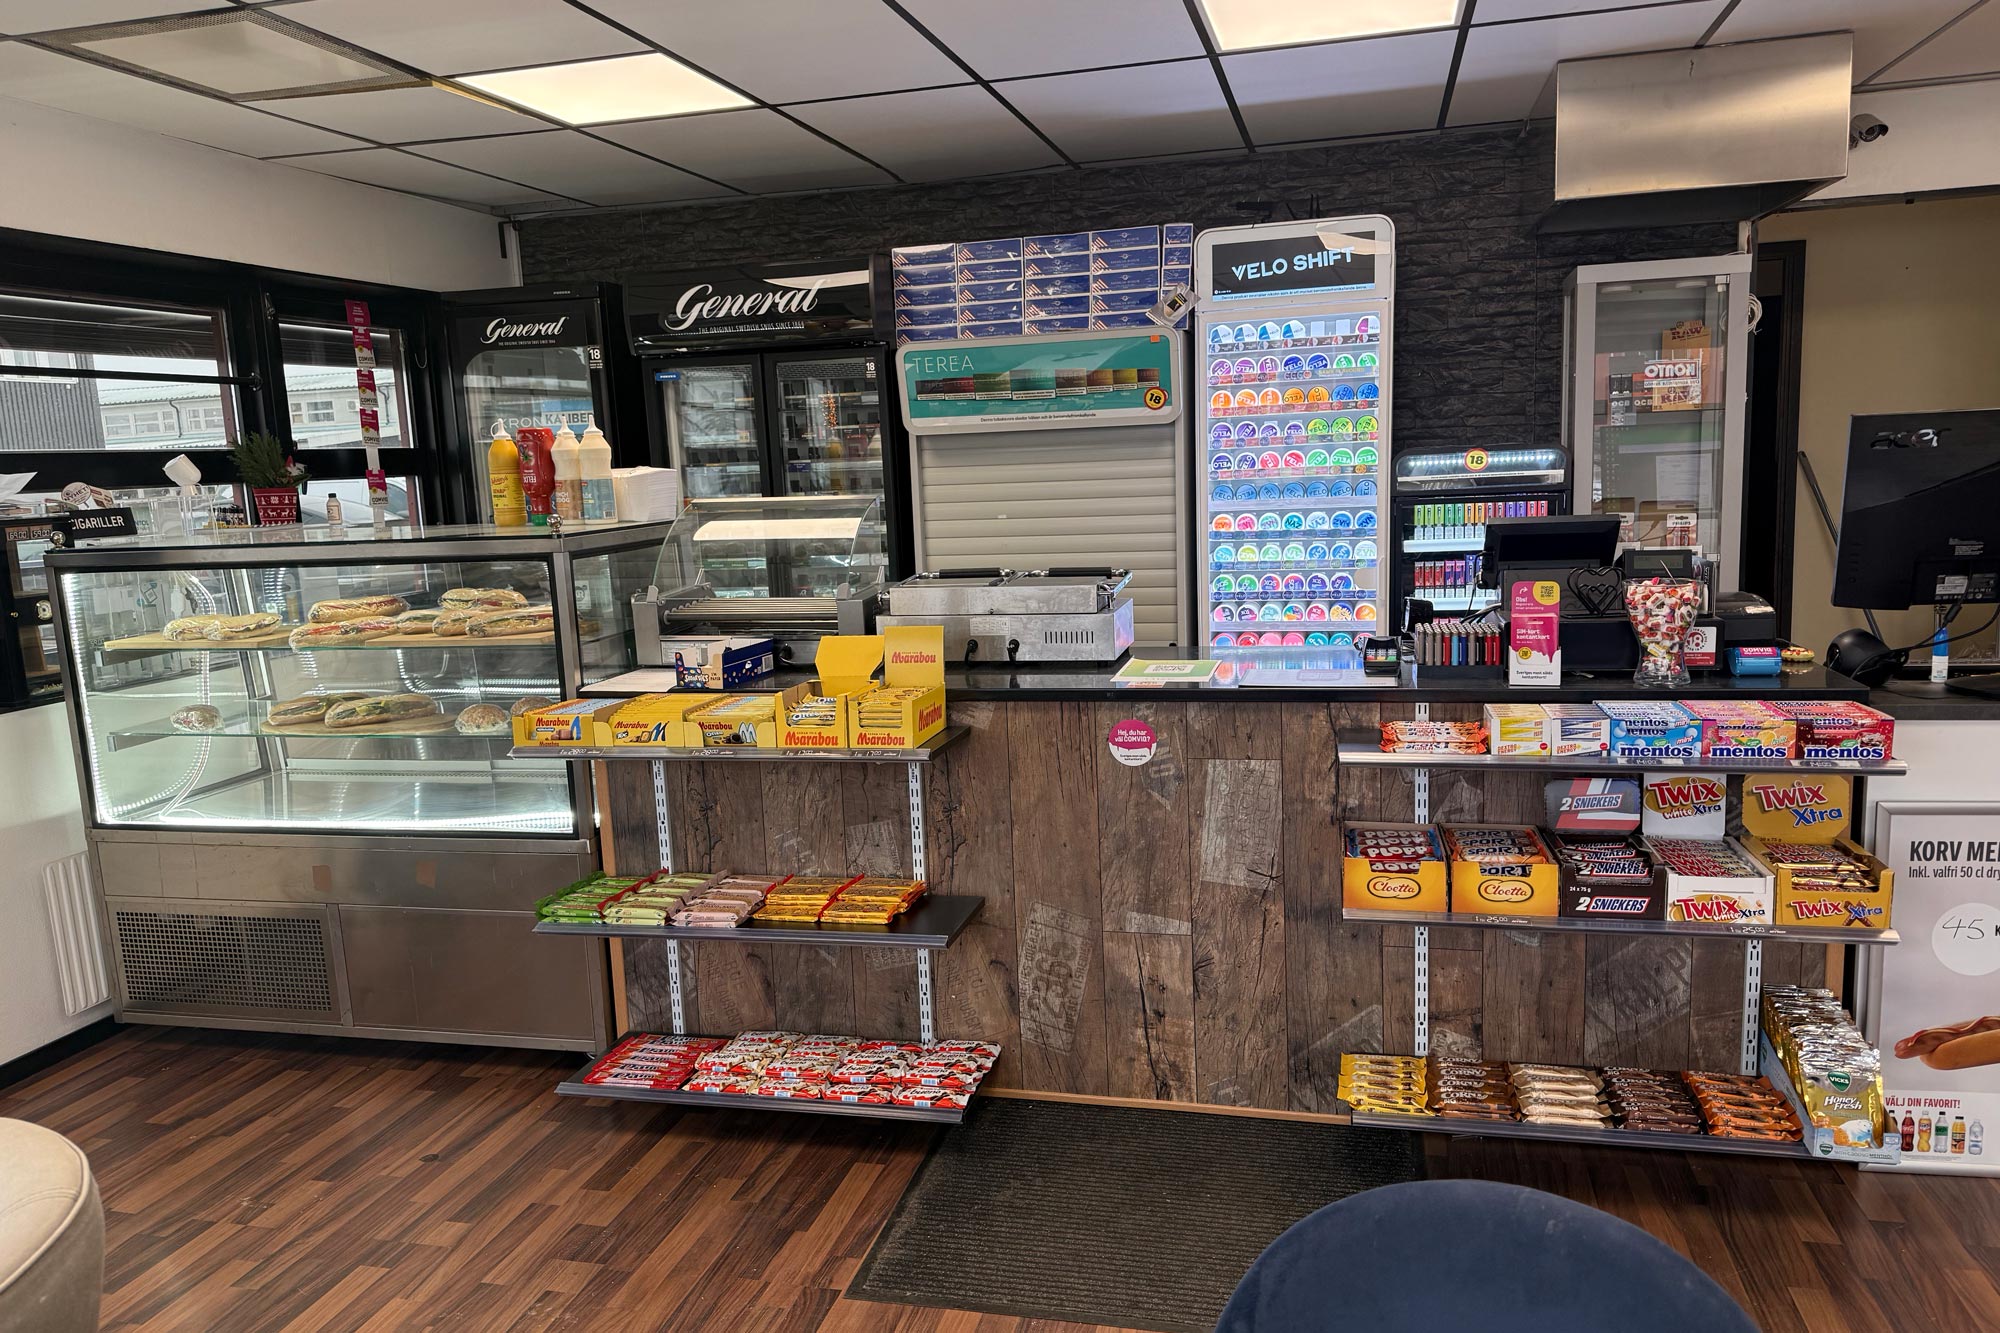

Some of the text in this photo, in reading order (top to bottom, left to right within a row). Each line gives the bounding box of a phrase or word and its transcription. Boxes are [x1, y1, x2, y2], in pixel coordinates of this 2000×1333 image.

[1232, 246, 1355, 281] VELO SHIFT
[664, 279, 827, 331] General
[480, 316, 566, 344] General
[589, 349, 601, 360] 18
[866, 363, 875, 371] 18
[912, 355, 975, 375] TEREA
[1148, 393, 1162, 405] 18
[1470, 456, 1484, 465] 18
[891, 652, 936, 664] Marabou
[536, 717, 570, 727] Marabou
[918, 704, 943, 732] Marabou
[614, 721, 649, 729] Marabou
[699, 721, 733, 730] Marabou
[785, 731, 839, 746] Marabou
[857, 733, 905, 746] Marabou
[1676, 735, 1694, 745] mint
[1620, 745, 1694, 757] mentos
[1710, 745, 1787, 758] mentos
[1805, 746, 1884, 759] mentos
[1649, 778, 1722, 808] Twix
[1754, 781, 1829, 811] Twix
[1560, 796, 1620, 811] 2 SNICKERS
[1663, 804, 1722, 819] white Xtra
[1792, 808, 1843, 827] Xtra
[1364, 830, 1423, 839] PLOPP
[1365, 838, 1424, 847] PLOPP
[1368, 845, 1428, 858] PLOPP
[1468, 846, 1529, 856] SPORT
[1910, 841, 1963, 862] KORV
[1909, 866, 1930, 878] Inkl.
[1933, 866, 1958, 878] valfri
[1960, 867, 1973, 878] 50
[1976, 866, 1984, 878] cl
[1372, 882, 1416, 894] Cloetta
[1484, 883, 1528, 897] Cloetta
[1576, 897, 1646, 912] 2 SNICKERS
[1675, 894, 1740, 921] Twix
[1792, 898, 1883, 919] Twix Xtra
[1713, 908, 1766, 921] white Xtra
[1942, 916, 1985, 940] 45
[612, 1072, 660, 1080] Daim
[1441, 1069, 1487, 1077] CORNY
[1438, 1080, 1485, 1088] CORNY
[1830, 1076, 1849, 1085] VICKS
[1441, 1092, 1488, 1100] CORNY
[1824, 1096, 1857, 1106] Honey
[1885, 1096, 1961, 1109] VÄLJ DIN FAVORIT!
[1834, 1102, 1863, 1111] Fresh
